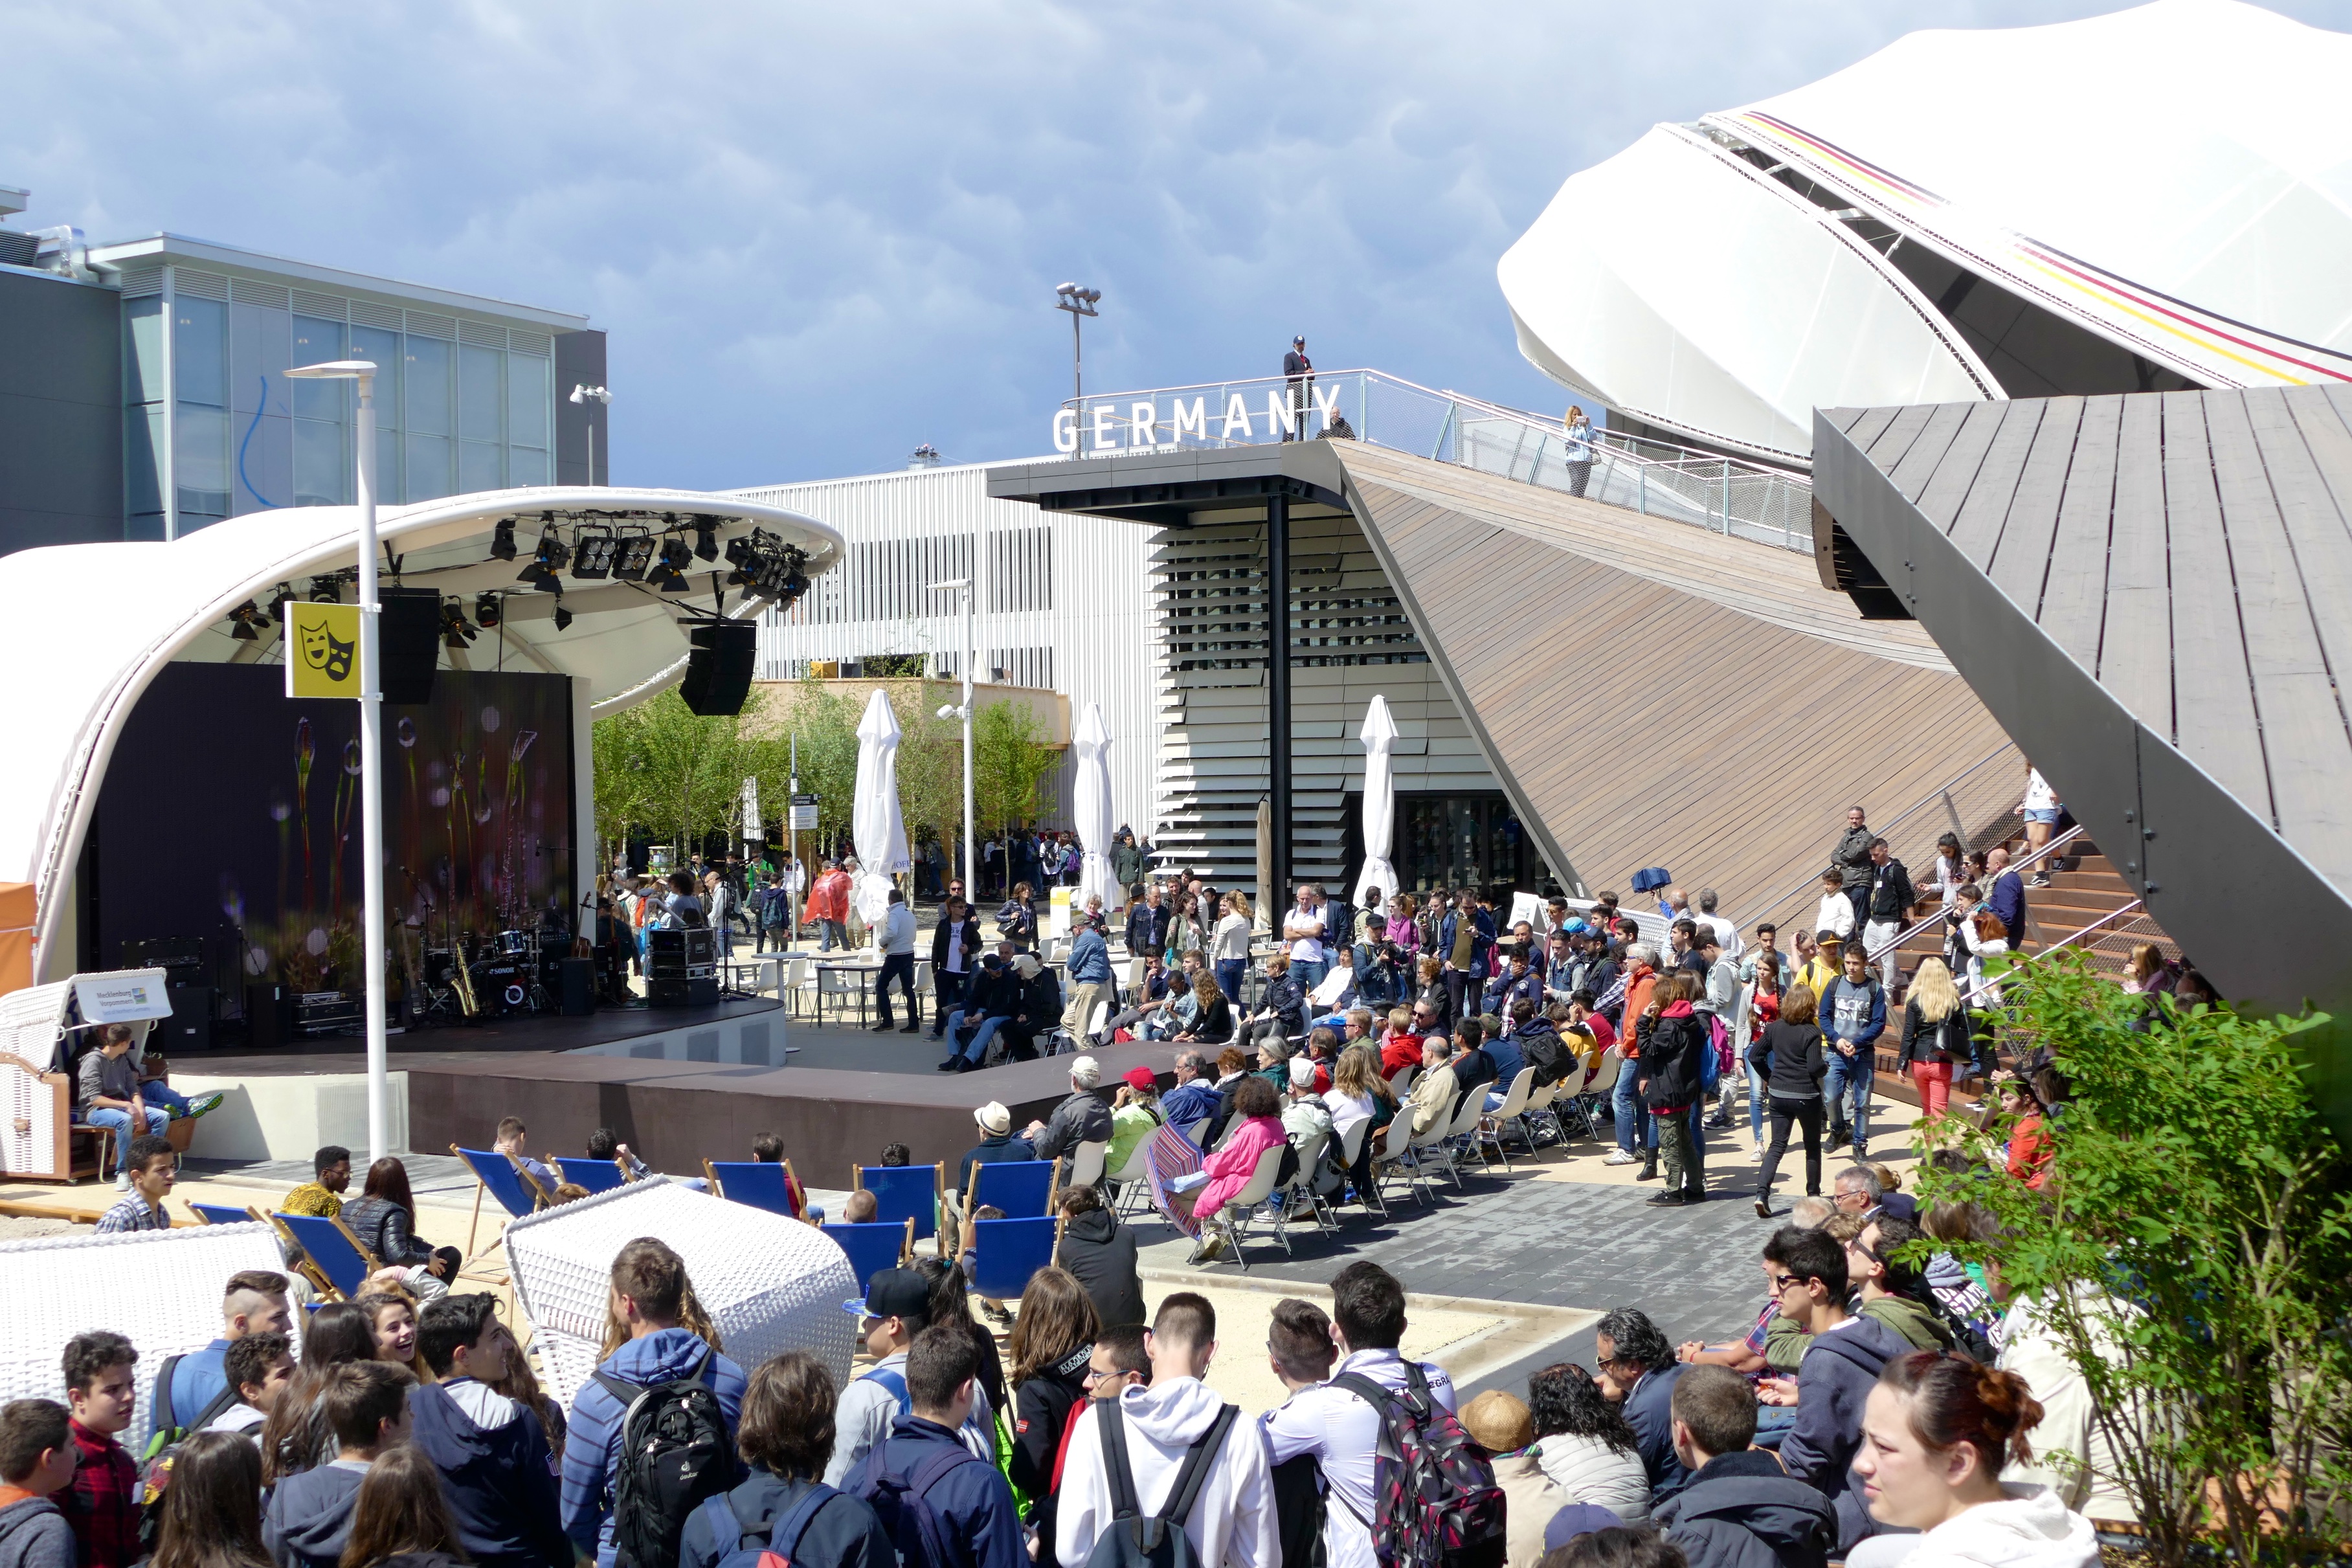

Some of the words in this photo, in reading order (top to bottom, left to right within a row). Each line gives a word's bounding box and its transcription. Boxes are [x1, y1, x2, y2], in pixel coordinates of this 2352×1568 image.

[1053, 385, 1340, 452] GERMANY
[97, 991, 131, 999] Mecklenburg
[99, 998, 133, 1007] Vorpommern
[1835, 998, 1864, 1011] JCK
[1834, 1010, 1869, 1022] JONES
[680, 1472, 699, 1480] deuter
